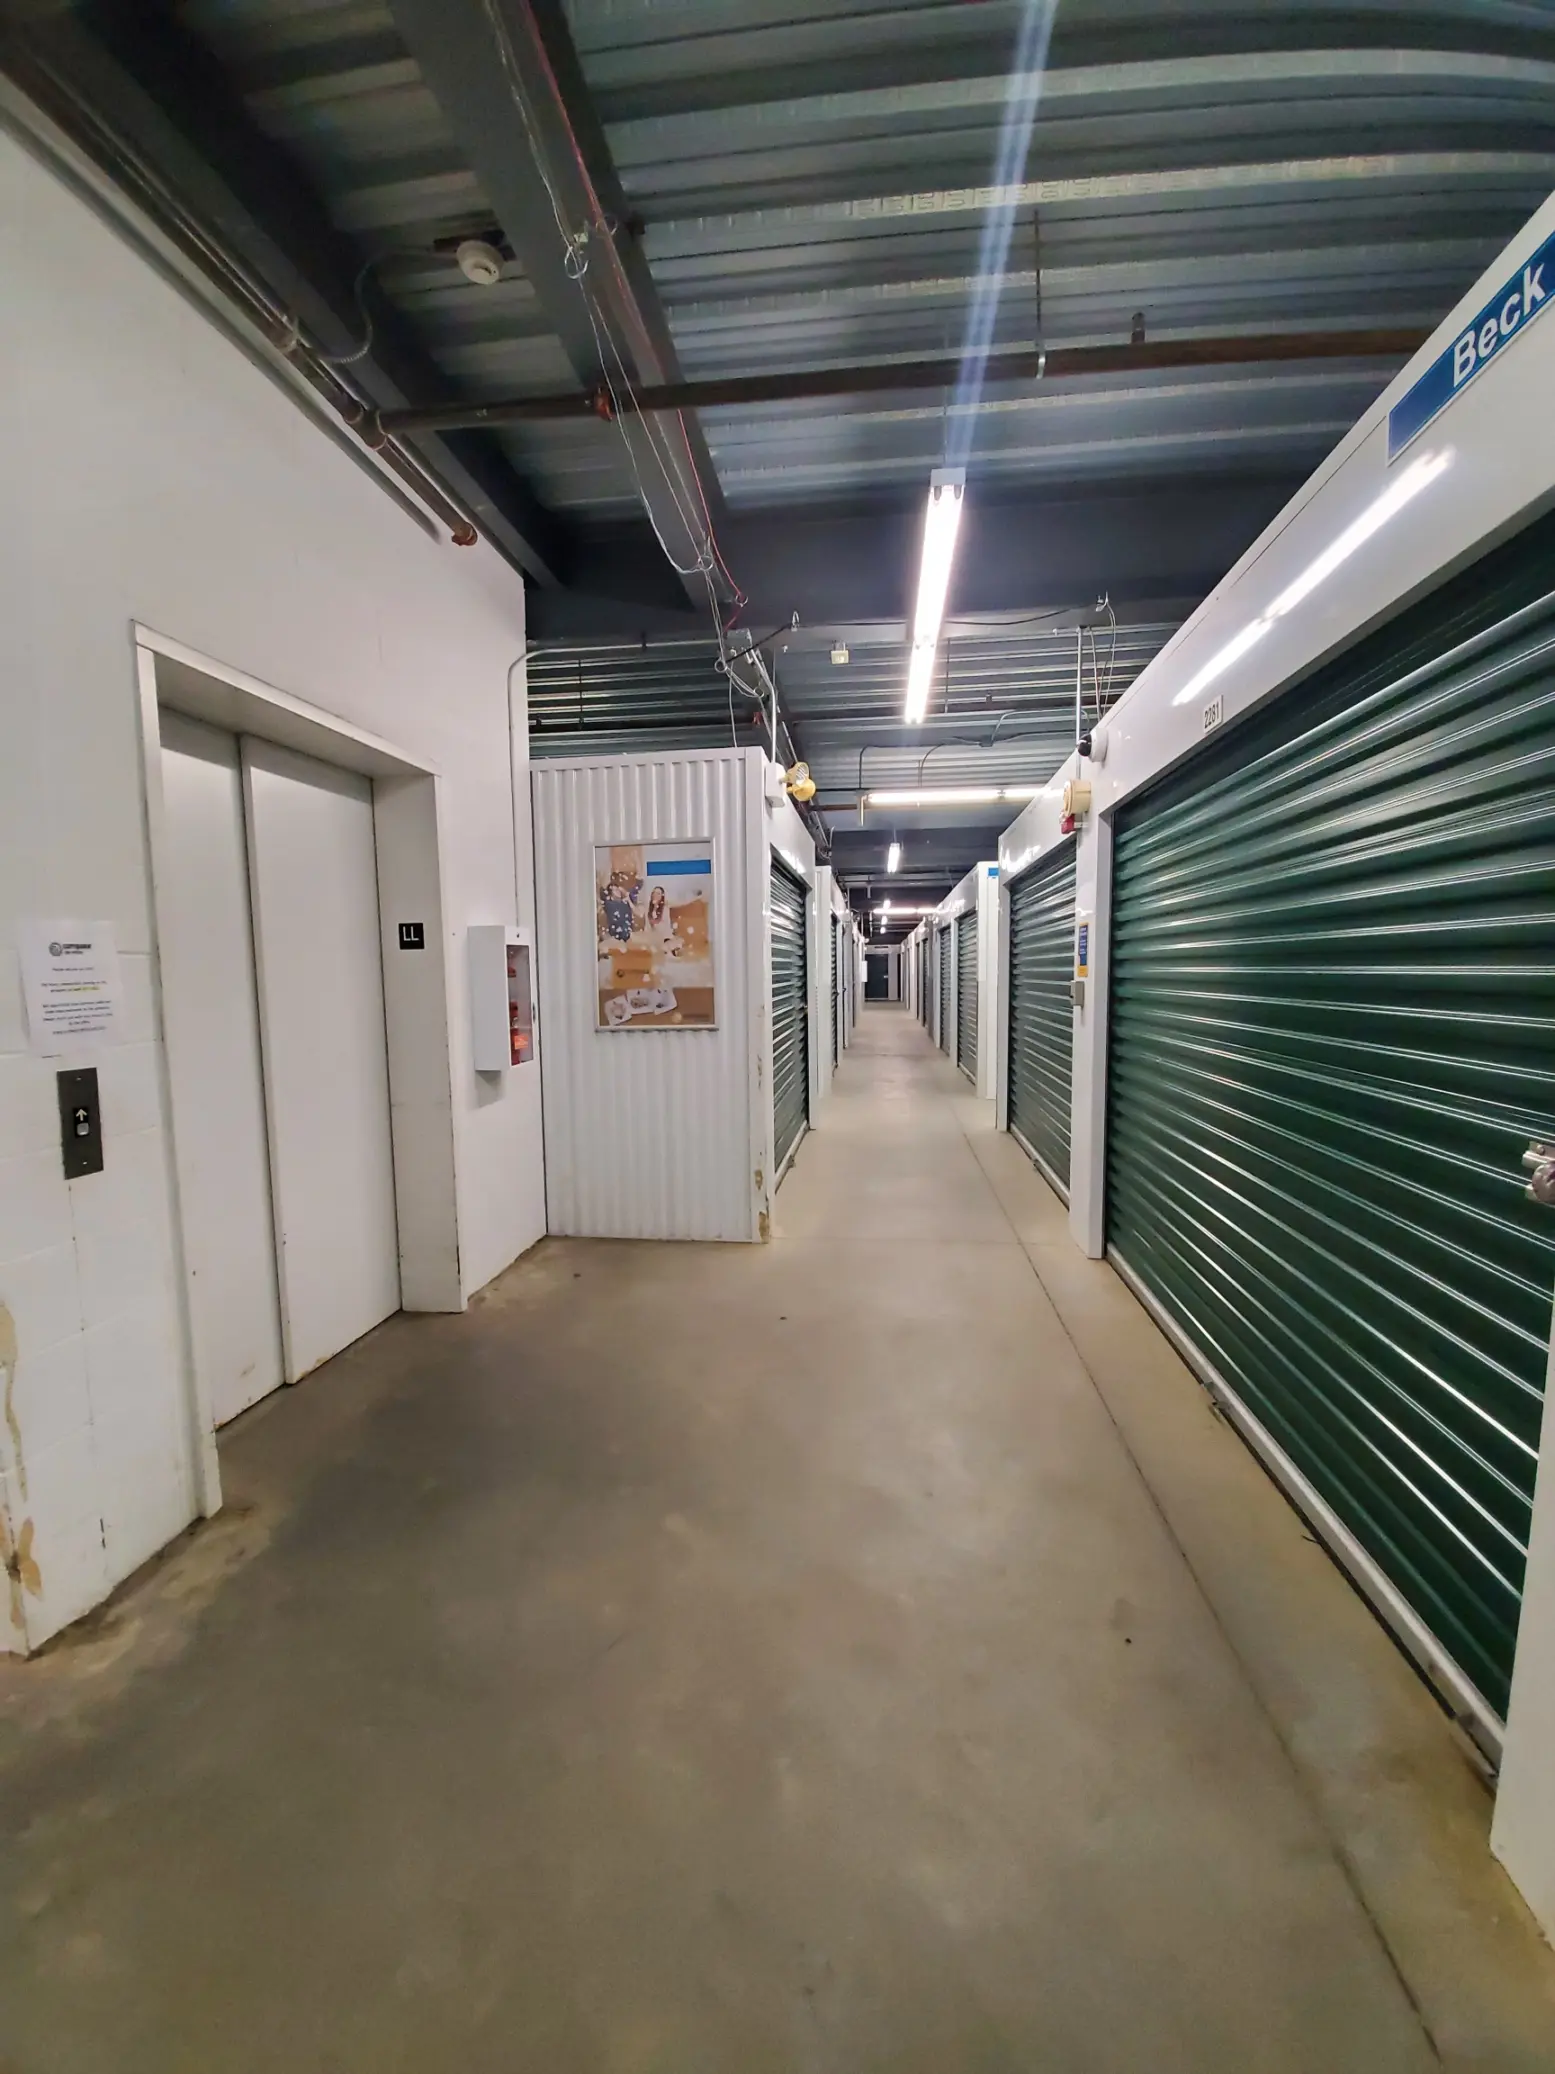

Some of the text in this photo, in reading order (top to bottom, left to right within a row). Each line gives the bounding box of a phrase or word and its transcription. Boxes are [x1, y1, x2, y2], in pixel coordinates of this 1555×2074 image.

[1453, 262, 1546, 388] Beck
[1204, 701, 1219, 729] 2281
[403, 926, 419, 941] LL
